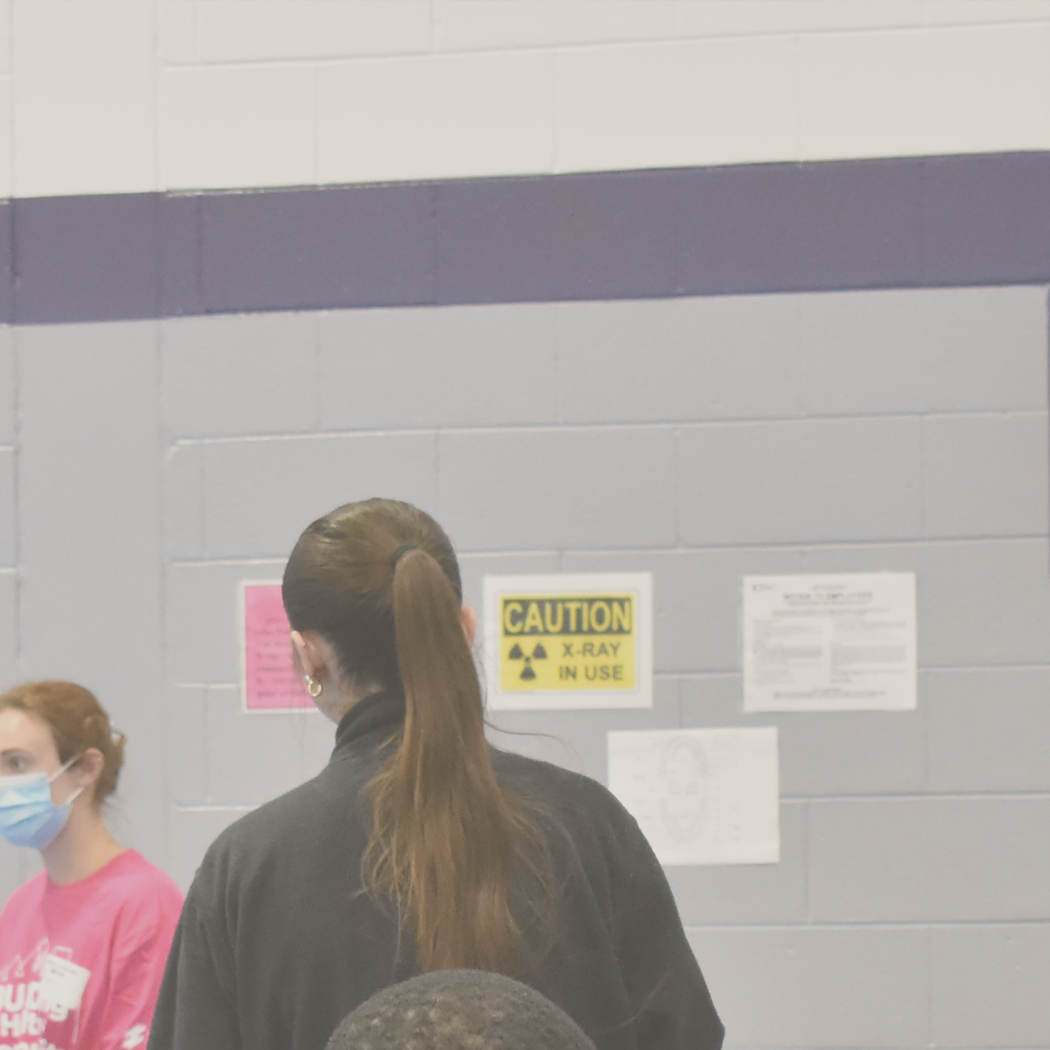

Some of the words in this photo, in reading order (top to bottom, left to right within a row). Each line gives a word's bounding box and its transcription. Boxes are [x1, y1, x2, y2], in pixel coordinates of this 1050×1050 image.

[504, 601, 631, 633] CAUTION
[561, 642, 622, 658] X-RAY
[558, 666, 578, 681] IN
[585, 665, 623, 680] USE
